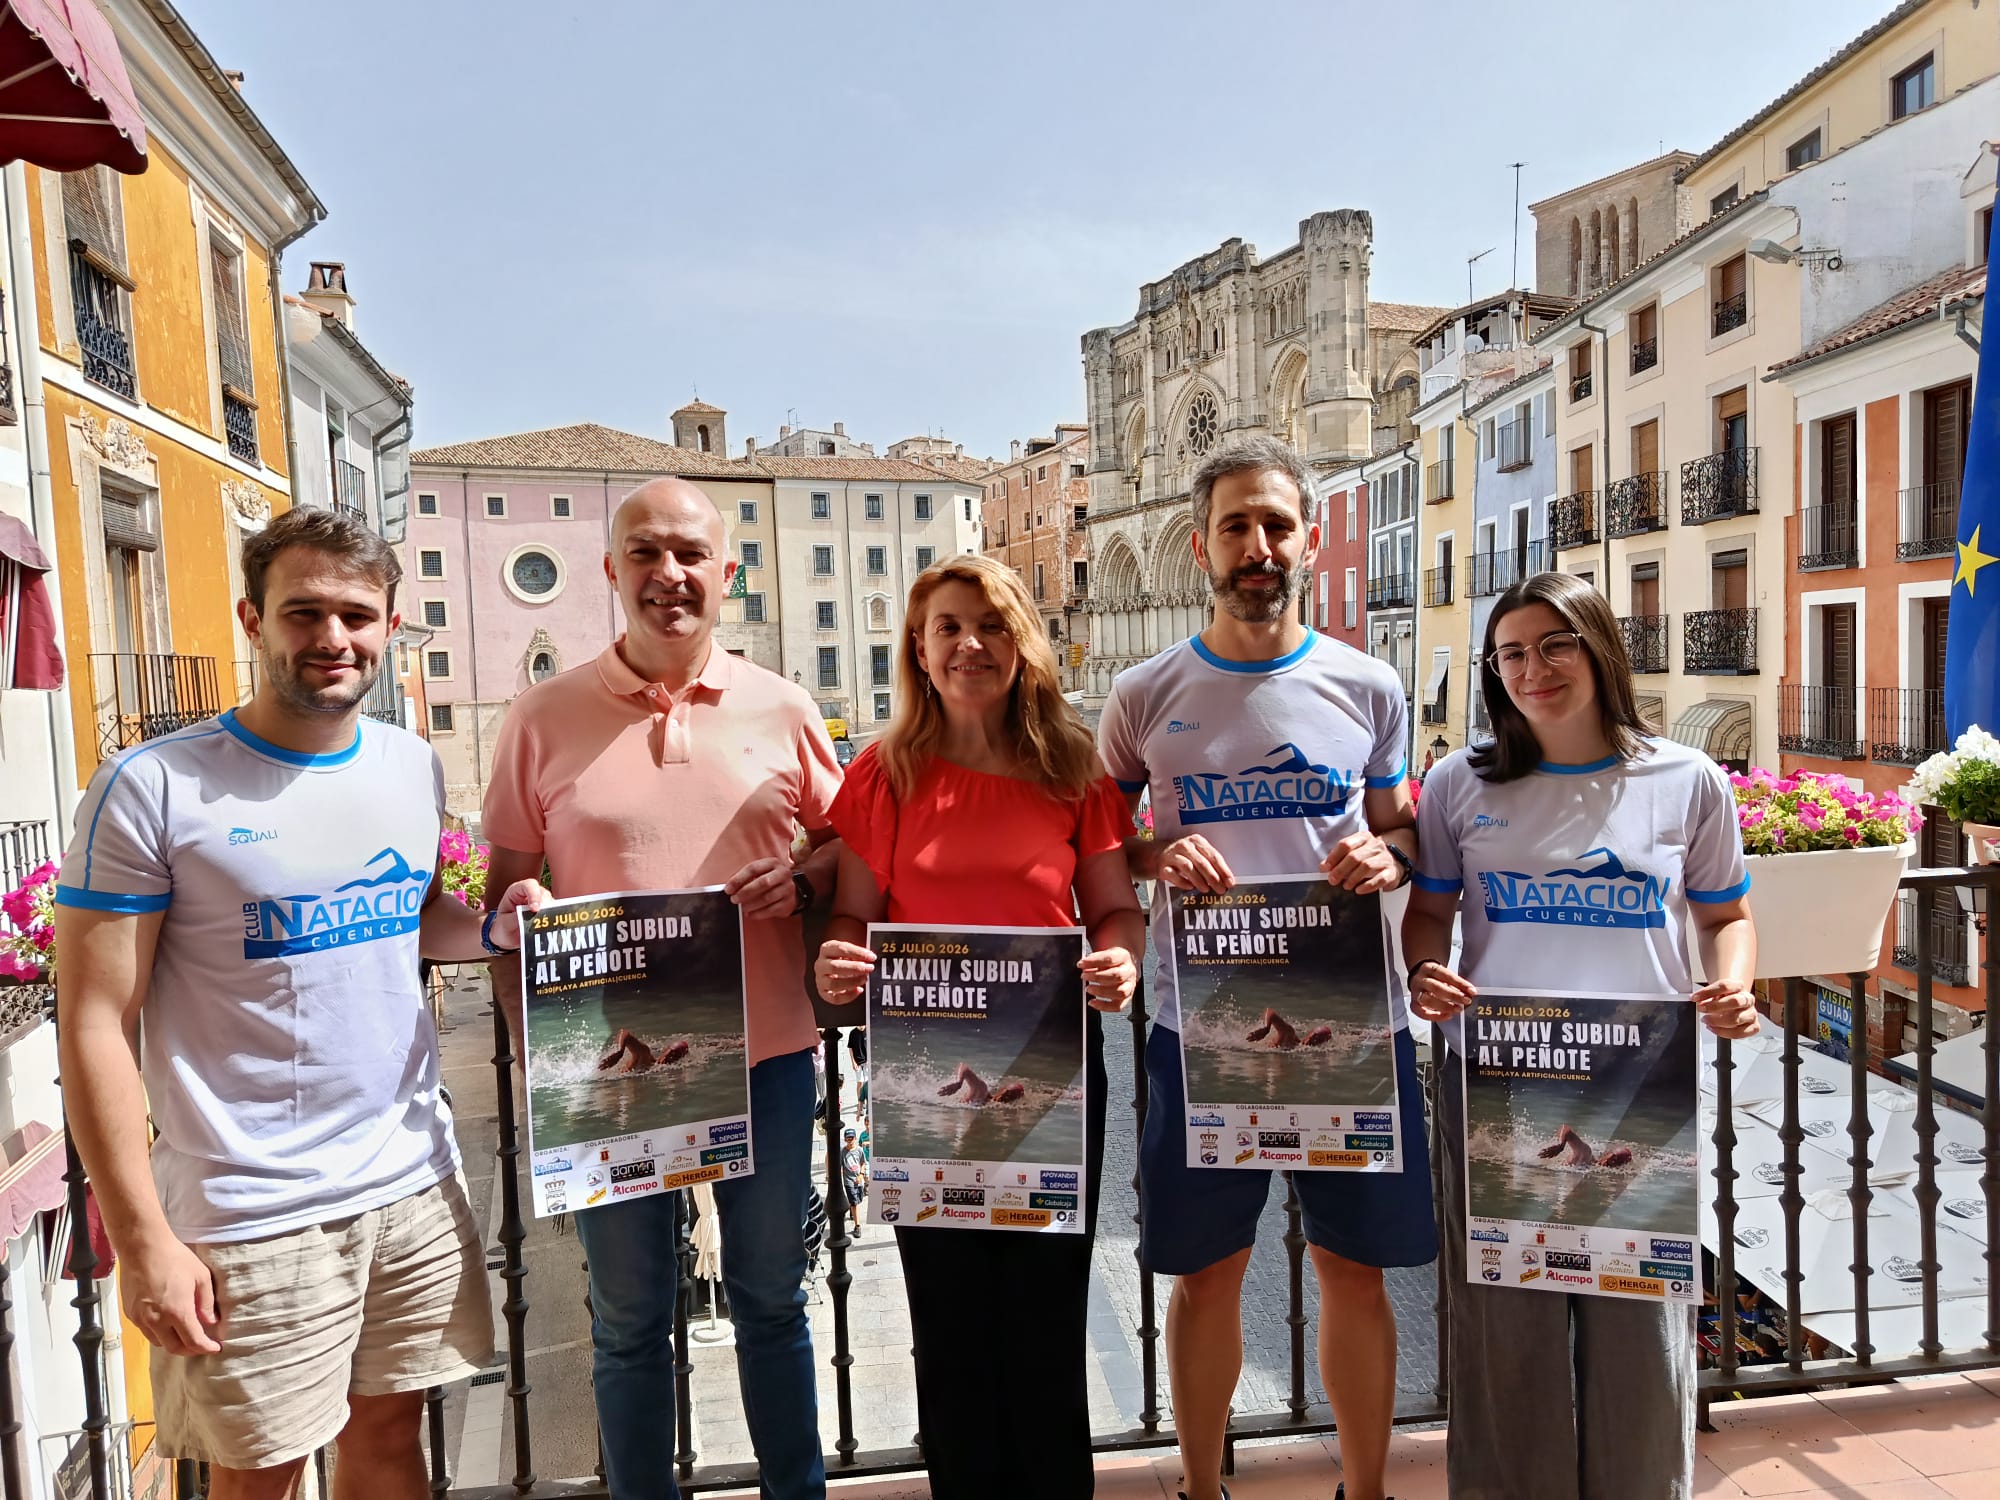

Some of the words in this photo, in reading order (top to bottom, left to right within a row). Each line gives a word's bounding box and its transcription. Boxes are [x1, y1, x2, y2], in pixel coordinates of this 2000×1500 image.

[1166, 721, 1200, 734] SQUALI
[1172, 776, 1187, 810] CLUB
[1182, 767, 1352, 810] NATACION
[1221, 805, 1305, 818] CUENCA
[1473, 817, 1509, 828] SQUALI
[228, 829, 278, 846] SQUALI
[1478, 871, 1493, 906] CLUB
[1485, 871, 1671, 912] NATACION
[1182, 895, 1196, 905] 25
[1200, 895, 1233, 905] JULIO
[1237, 894, 1267, 904] 2026
[242, 901, 261, 939] CLUB
[533, 917, 549, 929] 25
[553, 911, 590, 927] JULIO
[593, 906, 625, 920] 2026
[1183, 908, 1250, 930] LXXXIV
[1259, 905, 1332, 929] SUBIDA
[1525, 910, 1616, 924] CUENCA
[311, 920, 404, 948] CUENCA
[534, 923, 607, 957] LXXXIV
[616, 916, 693, 943] SUBIDA
[1186, 934, 1209, 955] AL
[1216, 929, 1289, 955] PEÑOTE
[882, 943, 896, 953] 25
[900, 944, 935, 953] JULIO
[939, 944, 969, 954] 2026
[535, 960, 561, 985] AL
[569, 946, 647, 979] PEÑOTE
[881, 958, 951, 981] LXXXIV
[960, 960, 1033, 983] SUBIDA
[881, 984, 905, 1006] AL
[914, 982, 987, 1009] PEÑOTE
[1822, 989, 1852, 1010] VISITA
[1477, 1006, 1492, 1016] 25
[1496, 1006, 1533, 1016] JULIO
[1538, 1007, 1570, 1018] 2026
[1819, 1000, 1852, 1025] GUIAD
[1477, 1019, 1551, 1043] LXXXIV
[1561, 1022, 1641, 1046] SUBIDA
[1478, 1045, 1503, 1066] AL
[1512, 1043, 1591, 1070] PEÑOTE
[711, 1122, 745, 1134] APOYANDO
[719, 1133, 747, 1143] DEPORTE
[1259, 1149, 1303, 1161] Alcampo
[612, 1180, 658, 1196] Alcampo
[1050, 1182, 1077, 1190] DEPORTE
[941, 1206, 986, 1220] Alcampo
[1652, 1241, 1690, 1249] APOYANDO
[1661, 1252, 1692, 1260] DEPORTE
[1545, 1269, 1593, 1285] Alcampo
